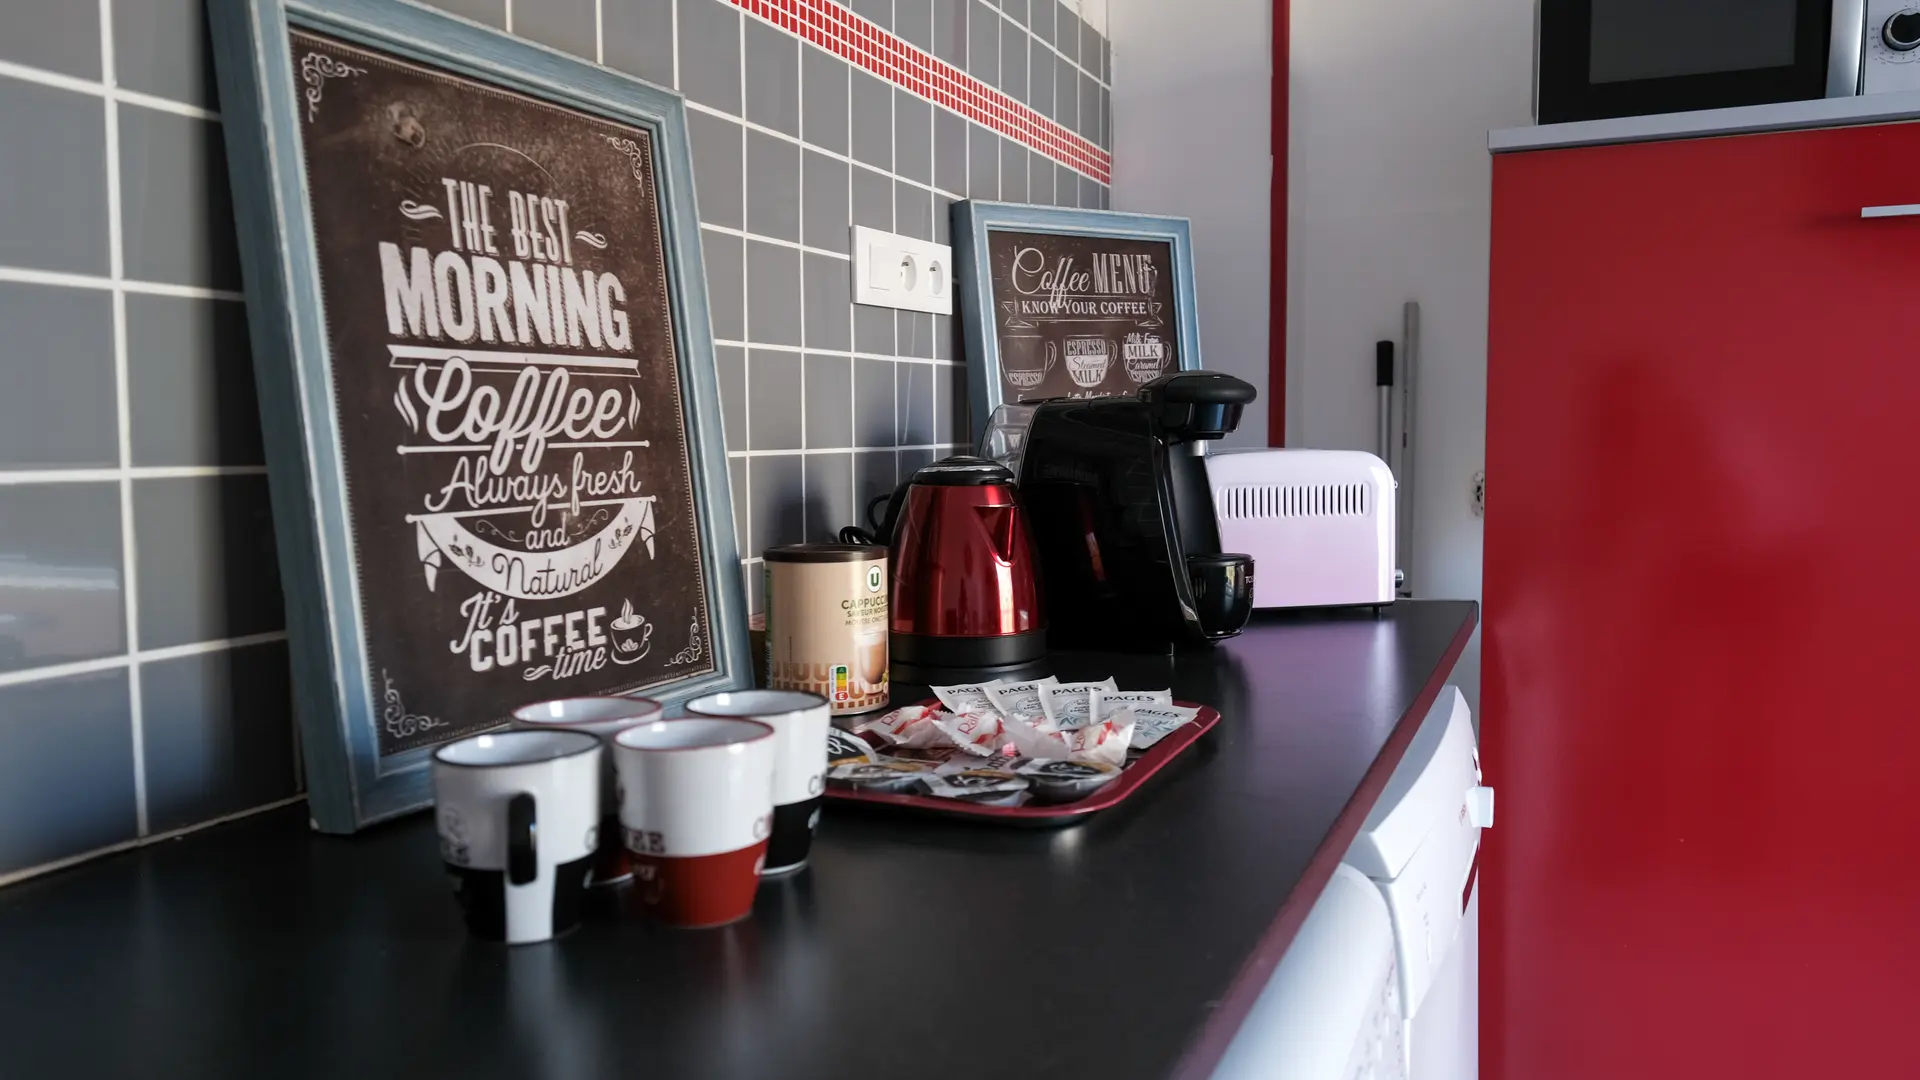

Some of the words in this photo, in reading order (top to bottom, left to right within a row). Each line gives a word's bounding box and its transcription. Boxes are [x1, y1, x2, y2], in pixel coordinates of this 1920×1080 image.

[442, 178, 498, 256] THE
[508, 190, 573, 265] BEST
[378, 241, 633, 353] MORNING
[1012, 245, 1091, 310] Coffee
[1022, 300, 1060, 315] KNOW
[1063, 300, 1098, 315] YOUR
[1100, 301, 1148, 315] COFFEE
[1066, 339, 1107, 356] ESPRESSO
[1127, 344, 1159, 358] MILK
[1127, 357, 1160, 372] Caramel
[1008, 372, 1043, 387] ESPRESSO
[1072, 369, 1104, 383] MILK
[413, 356, 627, 476] Coffee
[424, 455, 568, 528] Always
[570, 450, 642, 517] fresh
[525, 511, 570, 550] and
[491, 537, 604, 597] Natural
[870, 572, 880, 587] U
[449, 590, 520, 655] It's
[469, 606, 608, 673] COFFEE
[551, 645, 608, 681] time
